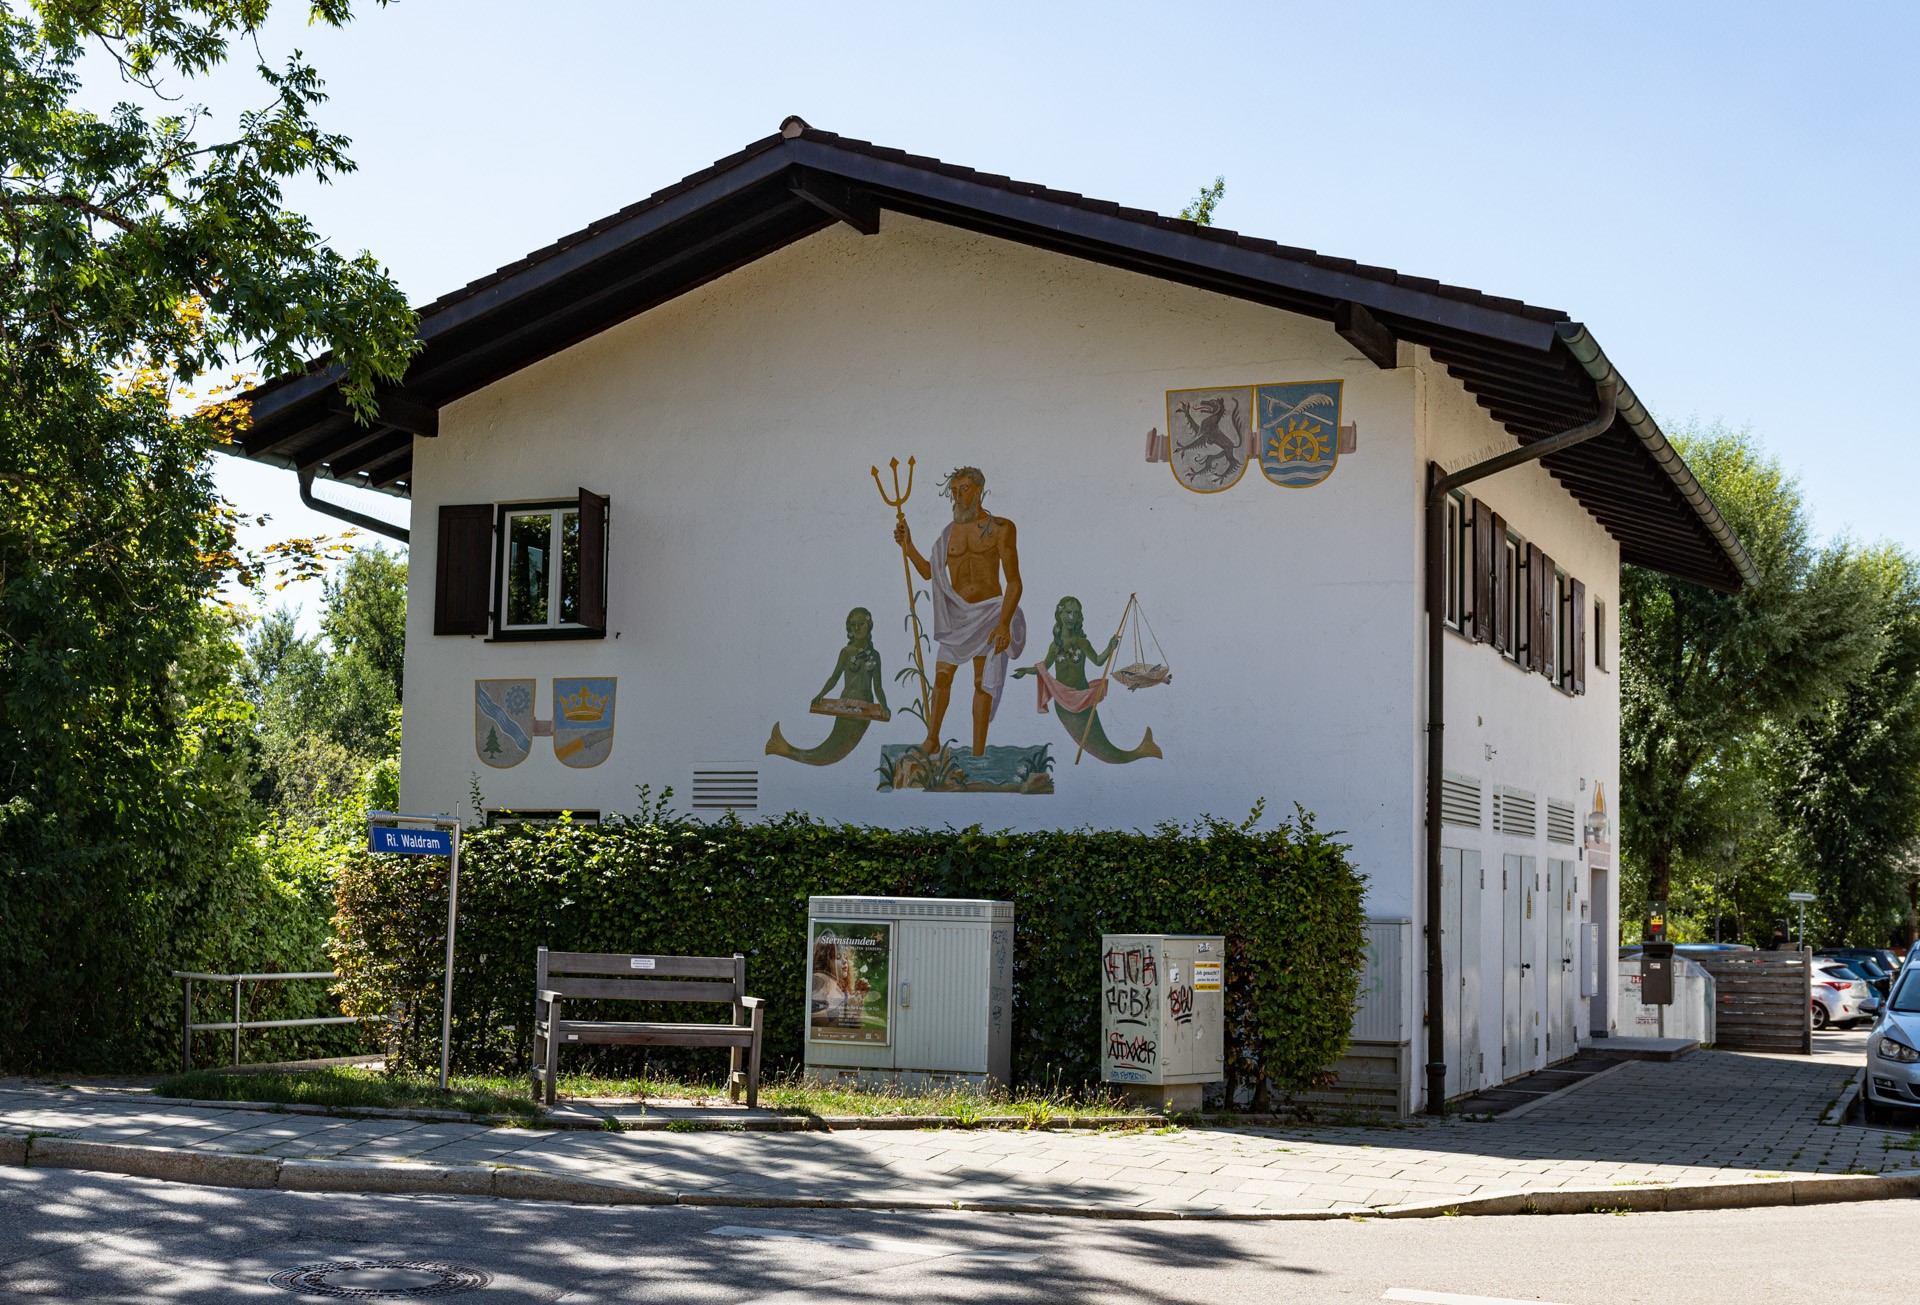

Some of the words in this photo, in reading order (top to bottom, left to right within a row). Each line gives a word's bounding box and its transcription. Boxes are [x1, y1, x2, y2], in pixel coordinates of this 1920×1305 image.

[386, 833, 399, 847] Ri.
[401, 834, 440, 848] Waldram
[821, 936, 876, 945] Sternstunden
